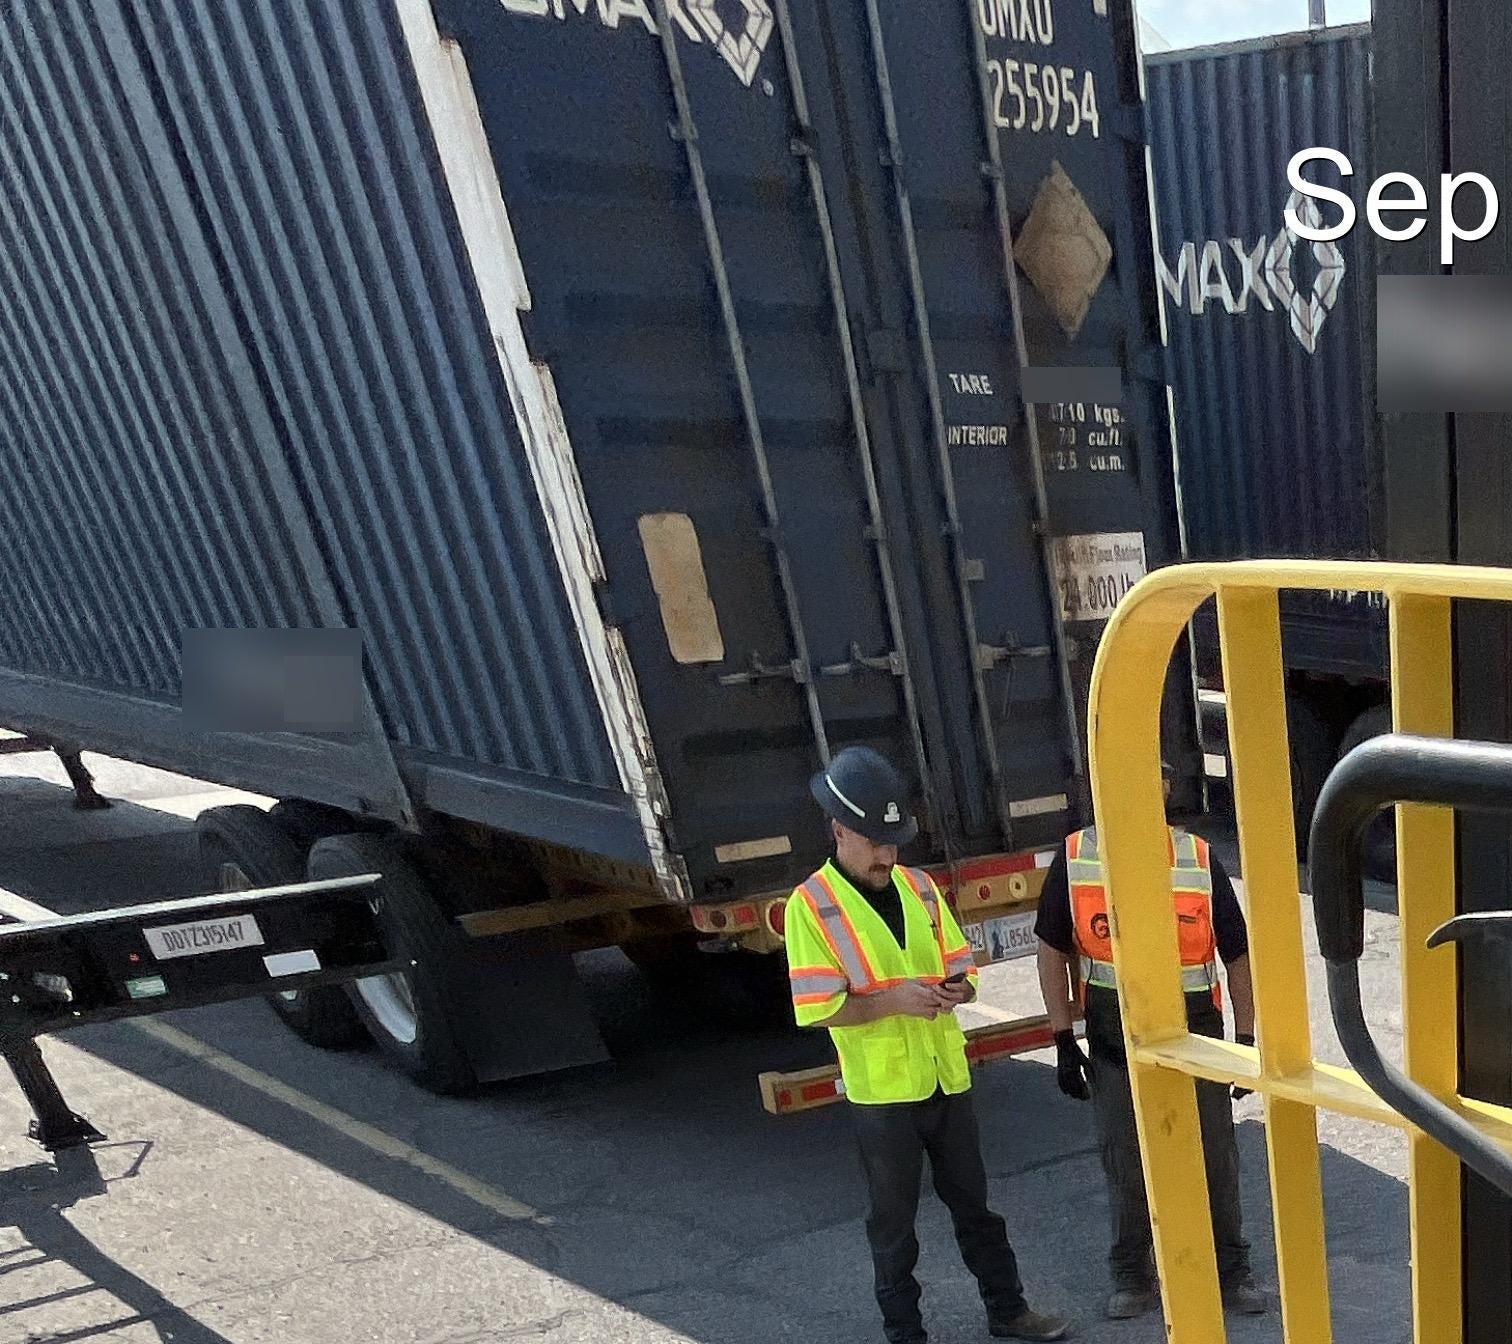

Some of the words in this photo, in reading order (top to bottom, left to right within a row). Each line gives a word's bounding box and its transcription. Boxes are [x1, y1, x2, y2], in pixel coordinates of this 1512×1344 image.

[986, 58, 1099, 138] 255954
[949, 373, 994, 395] TARE
[948, 425, 1008, 446] INTERIOR
